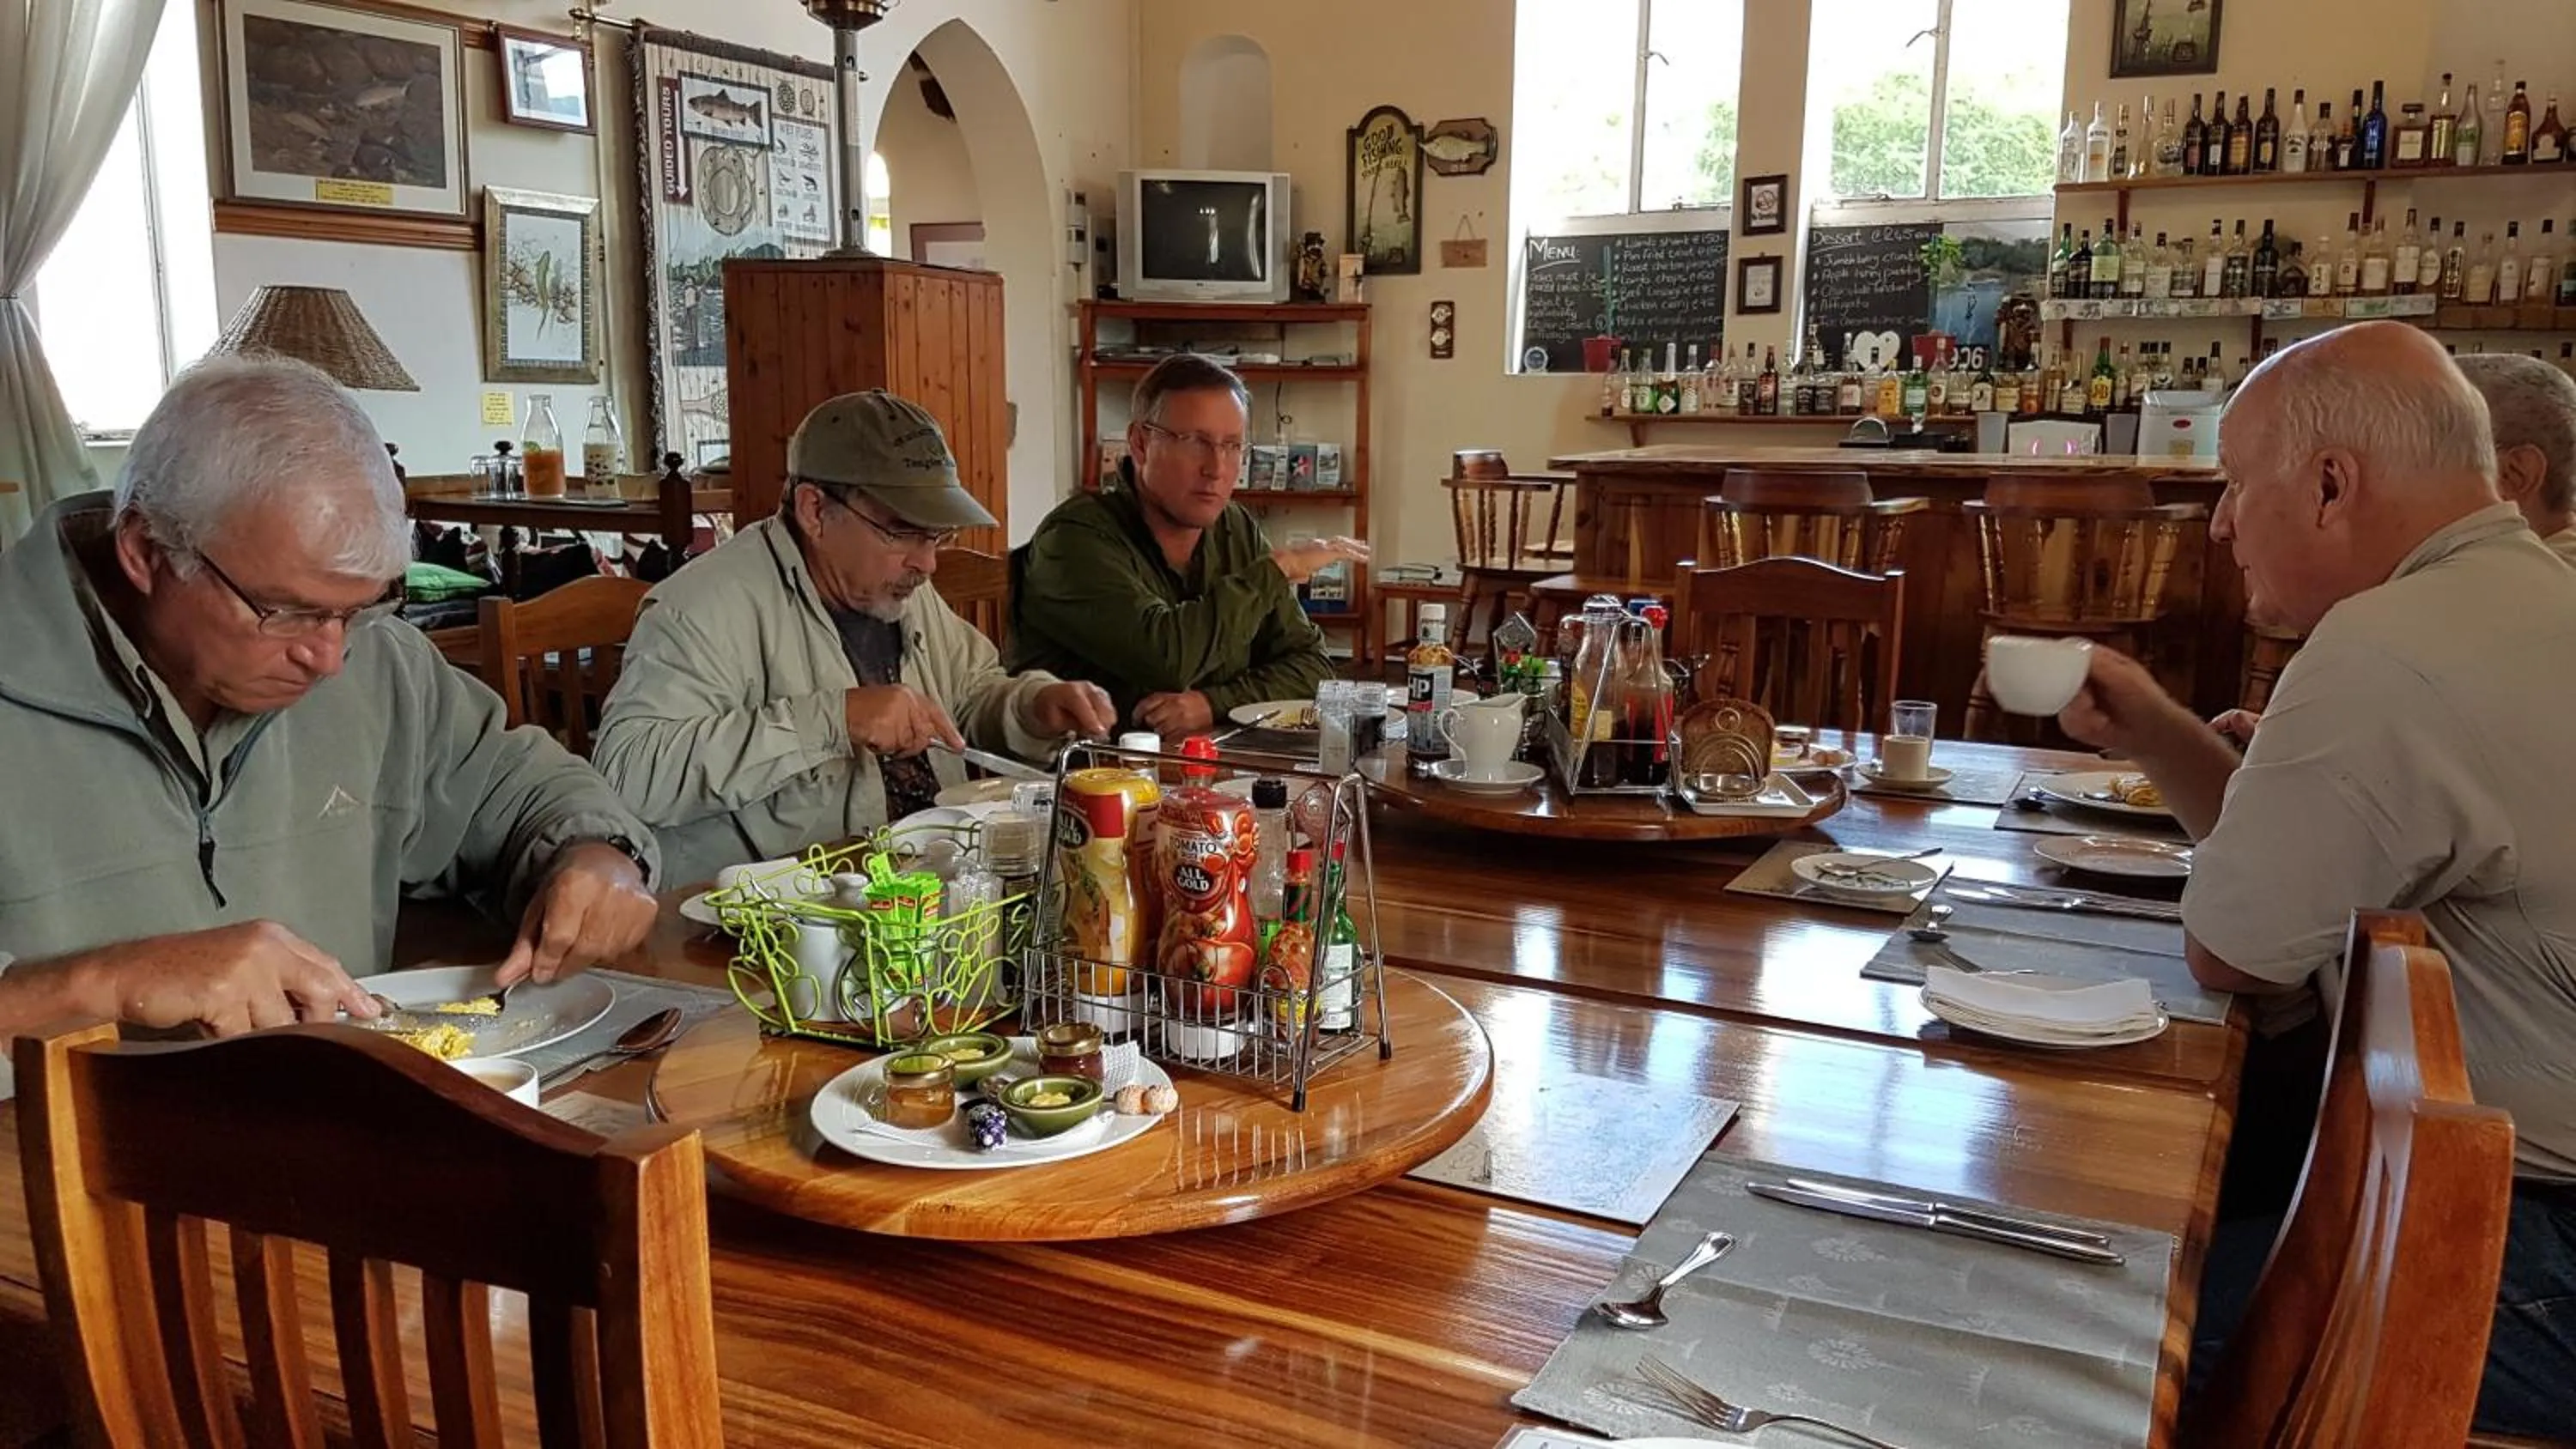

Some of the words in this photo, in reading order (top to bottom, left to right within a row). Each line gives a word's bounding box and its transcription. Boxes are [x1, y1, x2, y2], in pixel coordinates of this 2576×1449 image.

[661, 87, 673, 136] TOURS
[1364, 124, 1394, 150] GOOD
[1361, 136, 1402, 168] FISHING
[662, 140, 676, 195] GUIDED
[1813, 228, 1863, 246] Dessert
[1408, 676, 1431, 700] HP
[1169, 835, 1218, 855] TOMATO
[1176, 876, 1210, 892] GOLD
[1179, 865, 1206, 881] ALL
